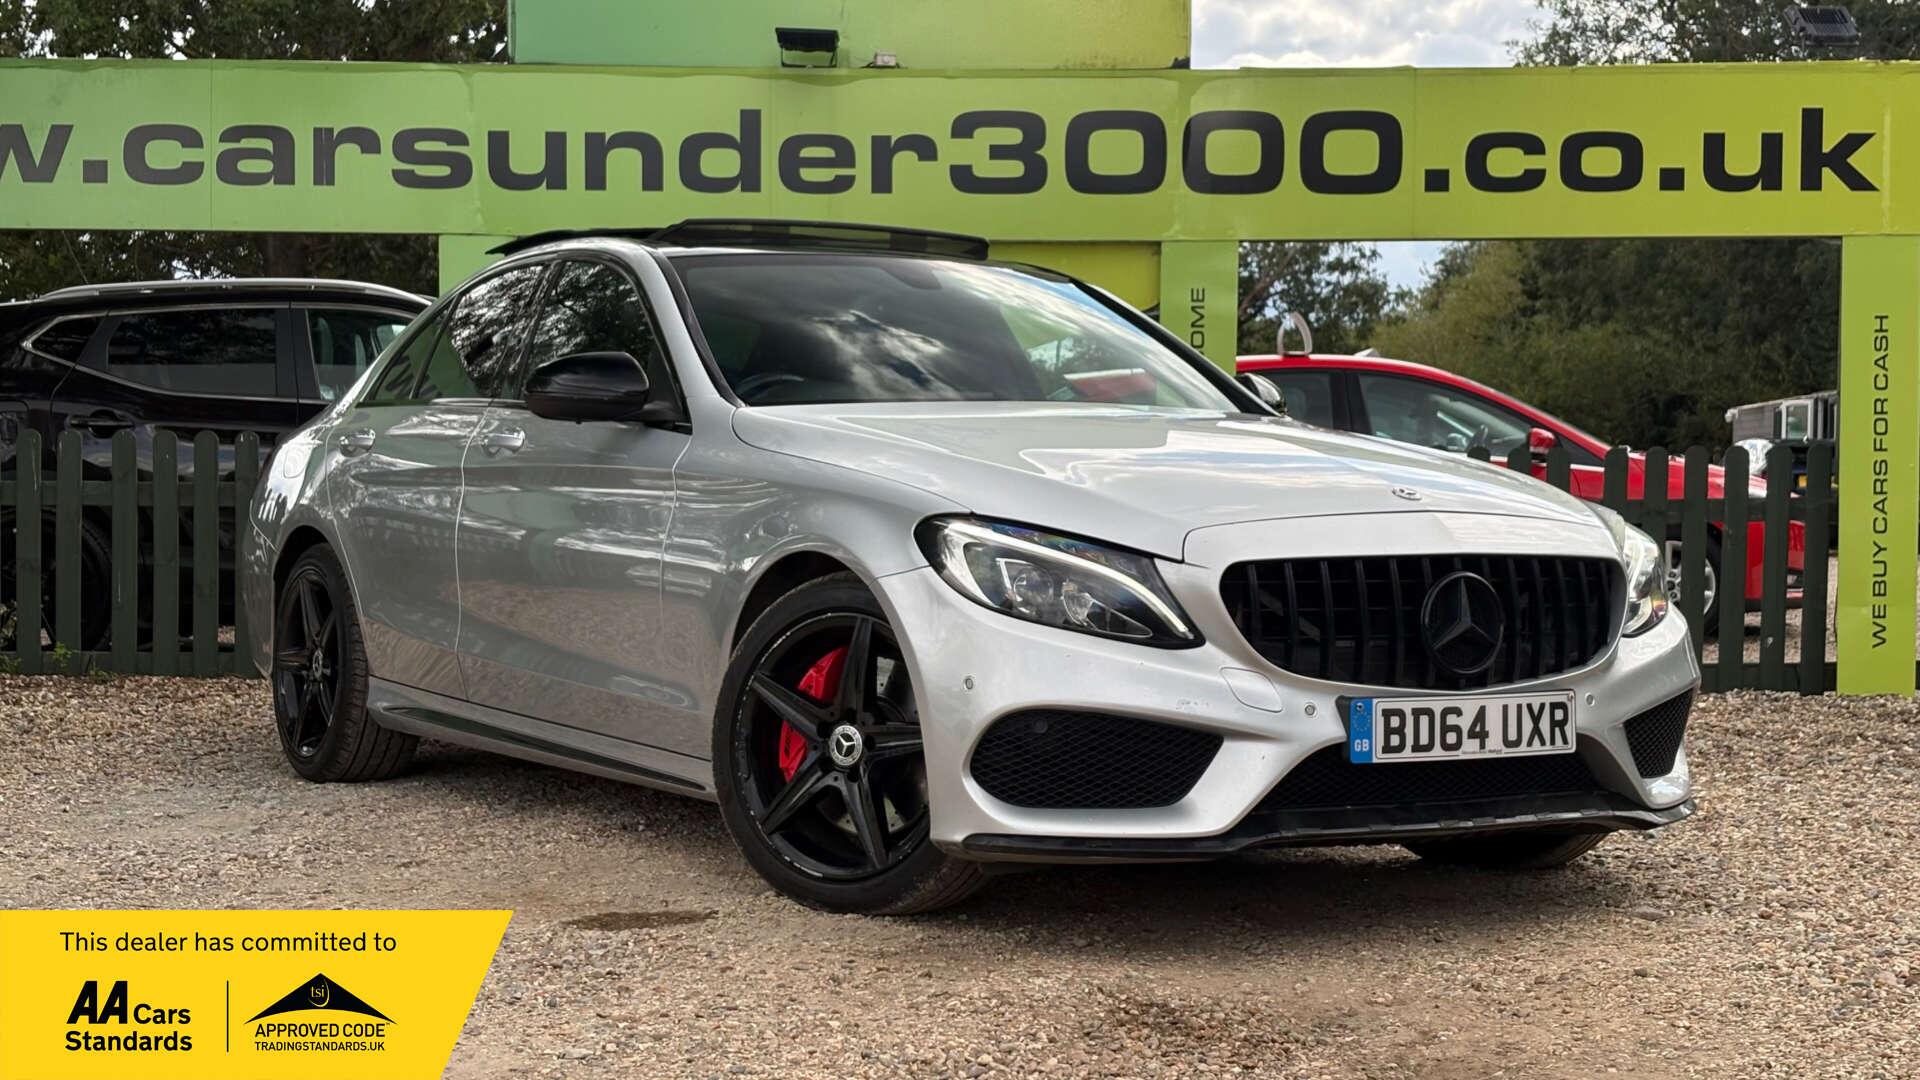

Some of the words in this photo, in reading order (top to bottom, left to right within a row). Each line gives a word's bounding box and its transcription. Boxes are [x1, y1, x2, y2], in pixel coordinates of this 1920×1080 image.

[1190, 287, 1206, 355] OME
[1873, 315, 1889, 391] CASH
[1873, 399, 1889, 452] FOR
[1872, 460, 1888, 534] CARS
[1872, 541, 1888, 597] BUY
[1872, 604, 1887, 649] WE
[1354, 738, 1369, 751] GB
[1381, 704, 1489, 755] BD64
[1502, 701, 1569, 748] UXR
